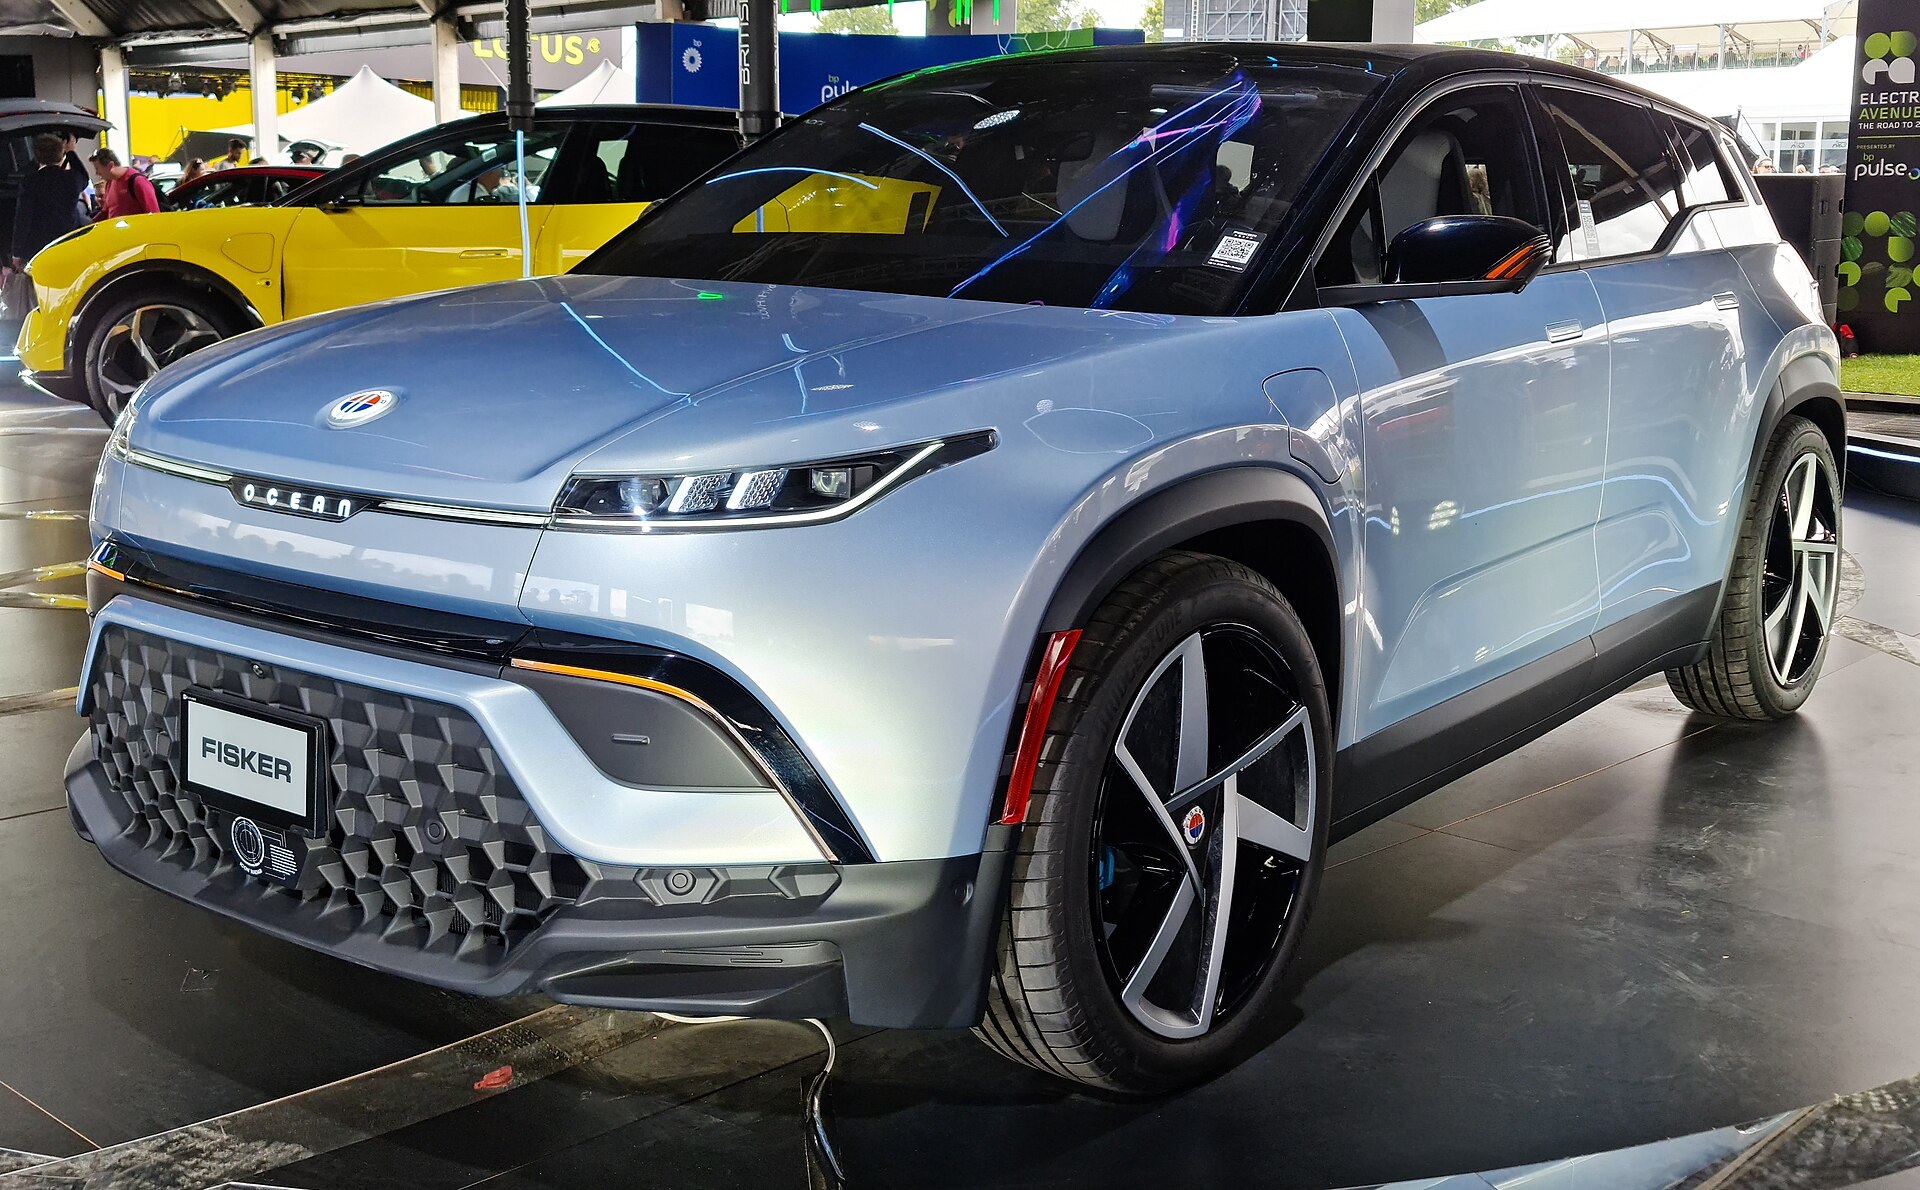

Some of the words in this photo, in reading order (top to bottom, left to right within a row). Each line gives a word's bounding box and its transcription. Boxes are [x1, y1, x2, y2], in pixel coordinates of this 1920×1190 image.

[739, 0, 750, 85] BRITIS
[828, 74, 840, 84] bp
[1860, 91, 1920, 105] ELECTR
[1859, 106, 1920, 120] AVENUE
[1858, 122, 1875, 130] THE
[1876, 121, 1900, 129] ROAD
[1863, 152, 1875, 162] bp
[1854, 158, 1908, 181] pulse
[243, 483, 351, 518] OCEAN
[201, 736, 292, 784] FISKER
